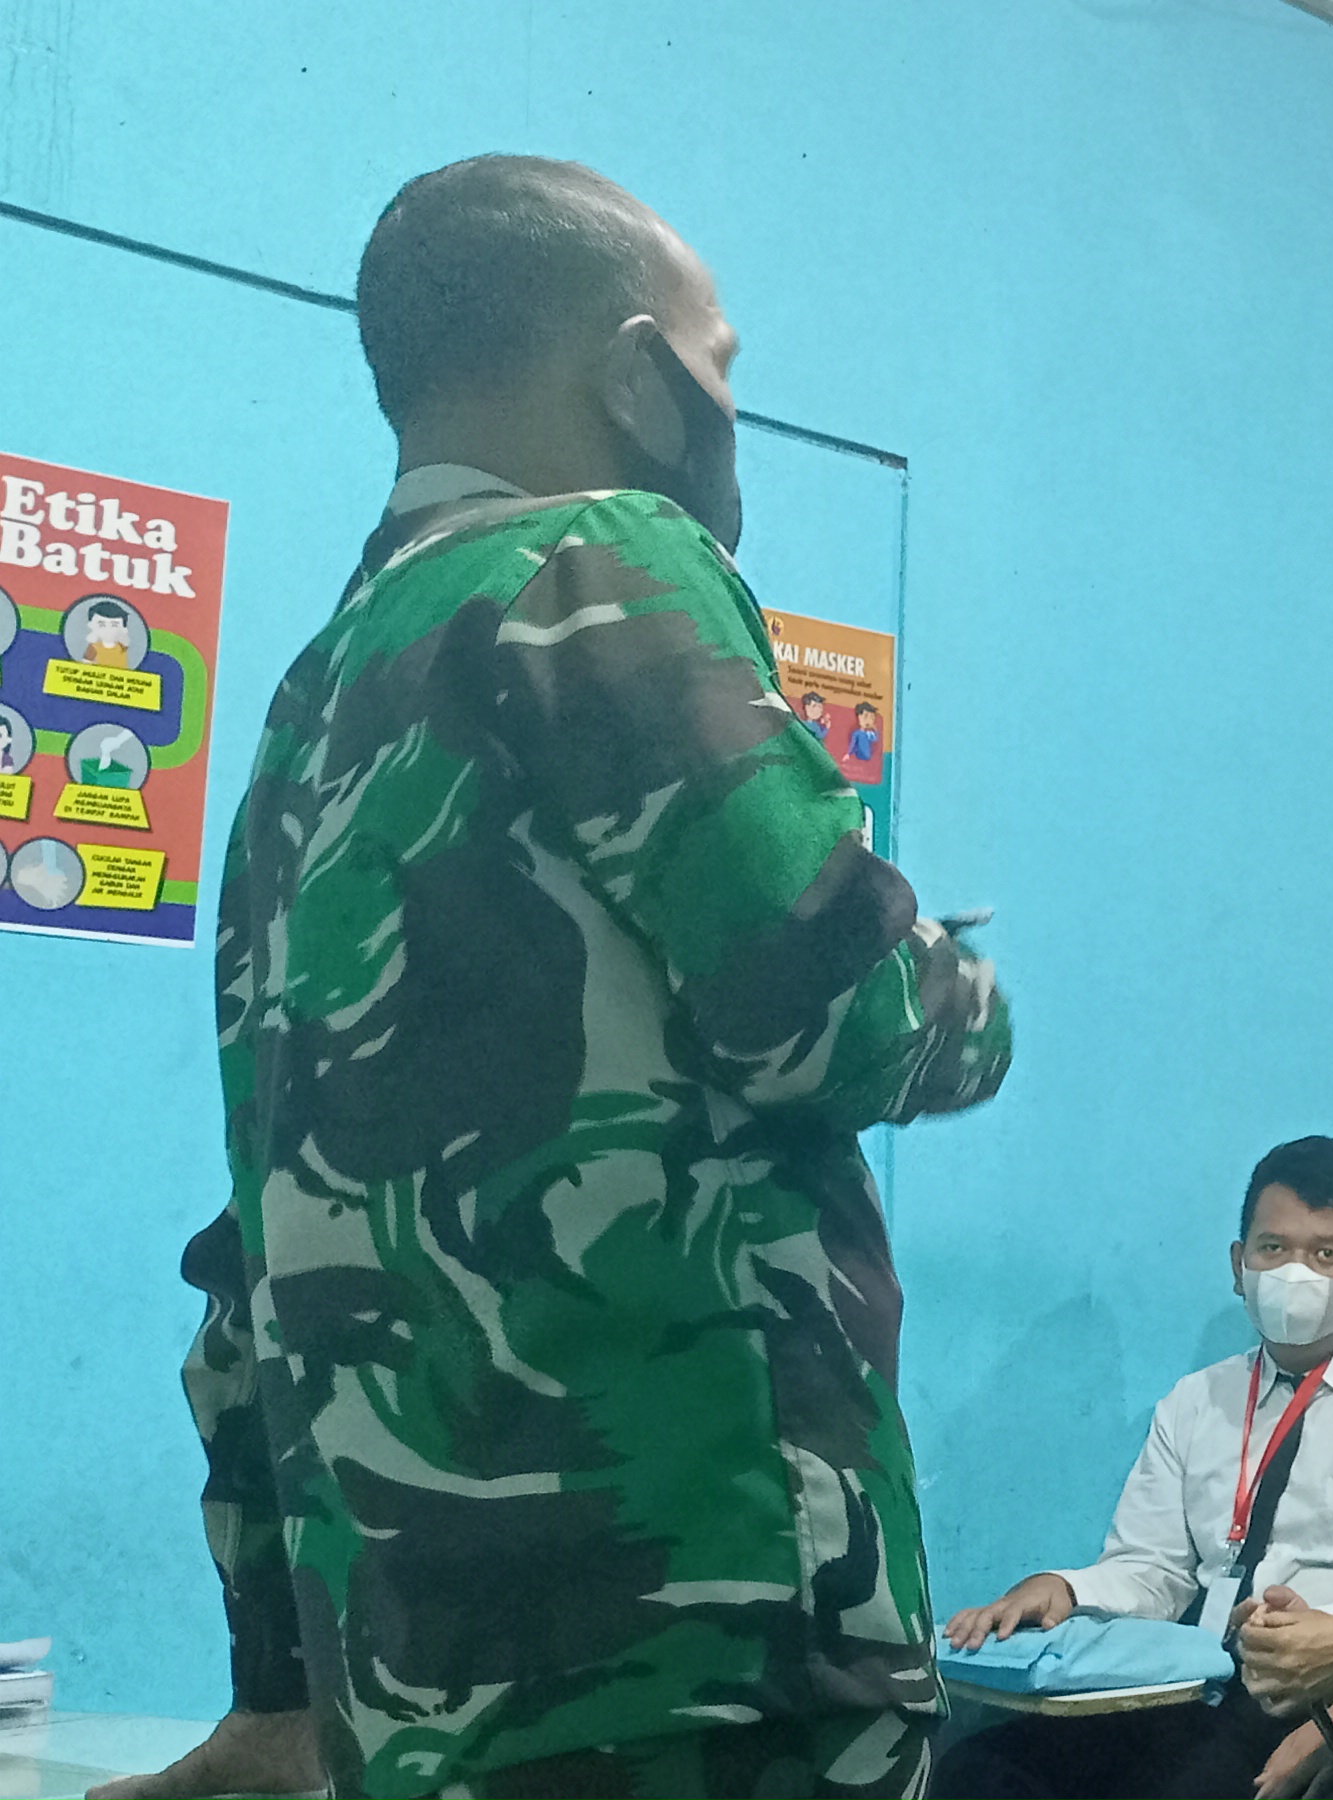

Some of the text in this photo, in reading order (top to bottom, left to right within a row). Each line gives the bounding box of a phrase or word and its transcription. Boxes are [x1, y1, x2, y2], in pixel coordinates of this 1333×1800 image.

[0, 475, 178, 552] Etika
[0, 520, 196, 598] Batuk
[803, 646, 865, 678] MASKER
